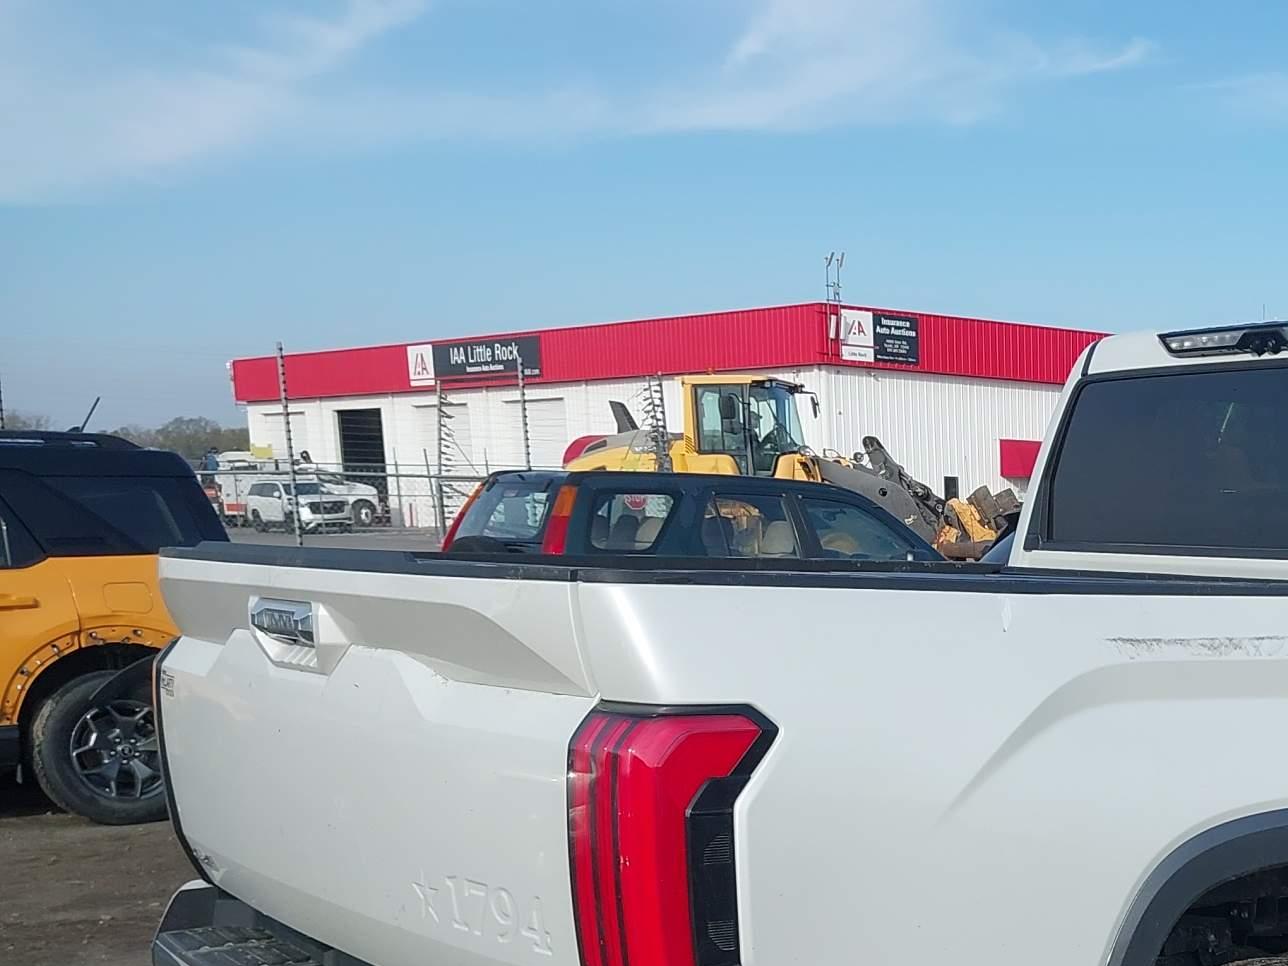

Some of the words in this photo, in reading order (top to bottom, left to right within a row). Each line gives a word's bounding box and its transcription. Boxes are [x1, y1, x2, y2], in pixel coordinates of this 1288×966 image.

[876, 326, 890, 335] Auto
[449, 346, 466, 365] IAA
[467, 345, 492, 363] Little
[494, 342, 519, 361] Rock
